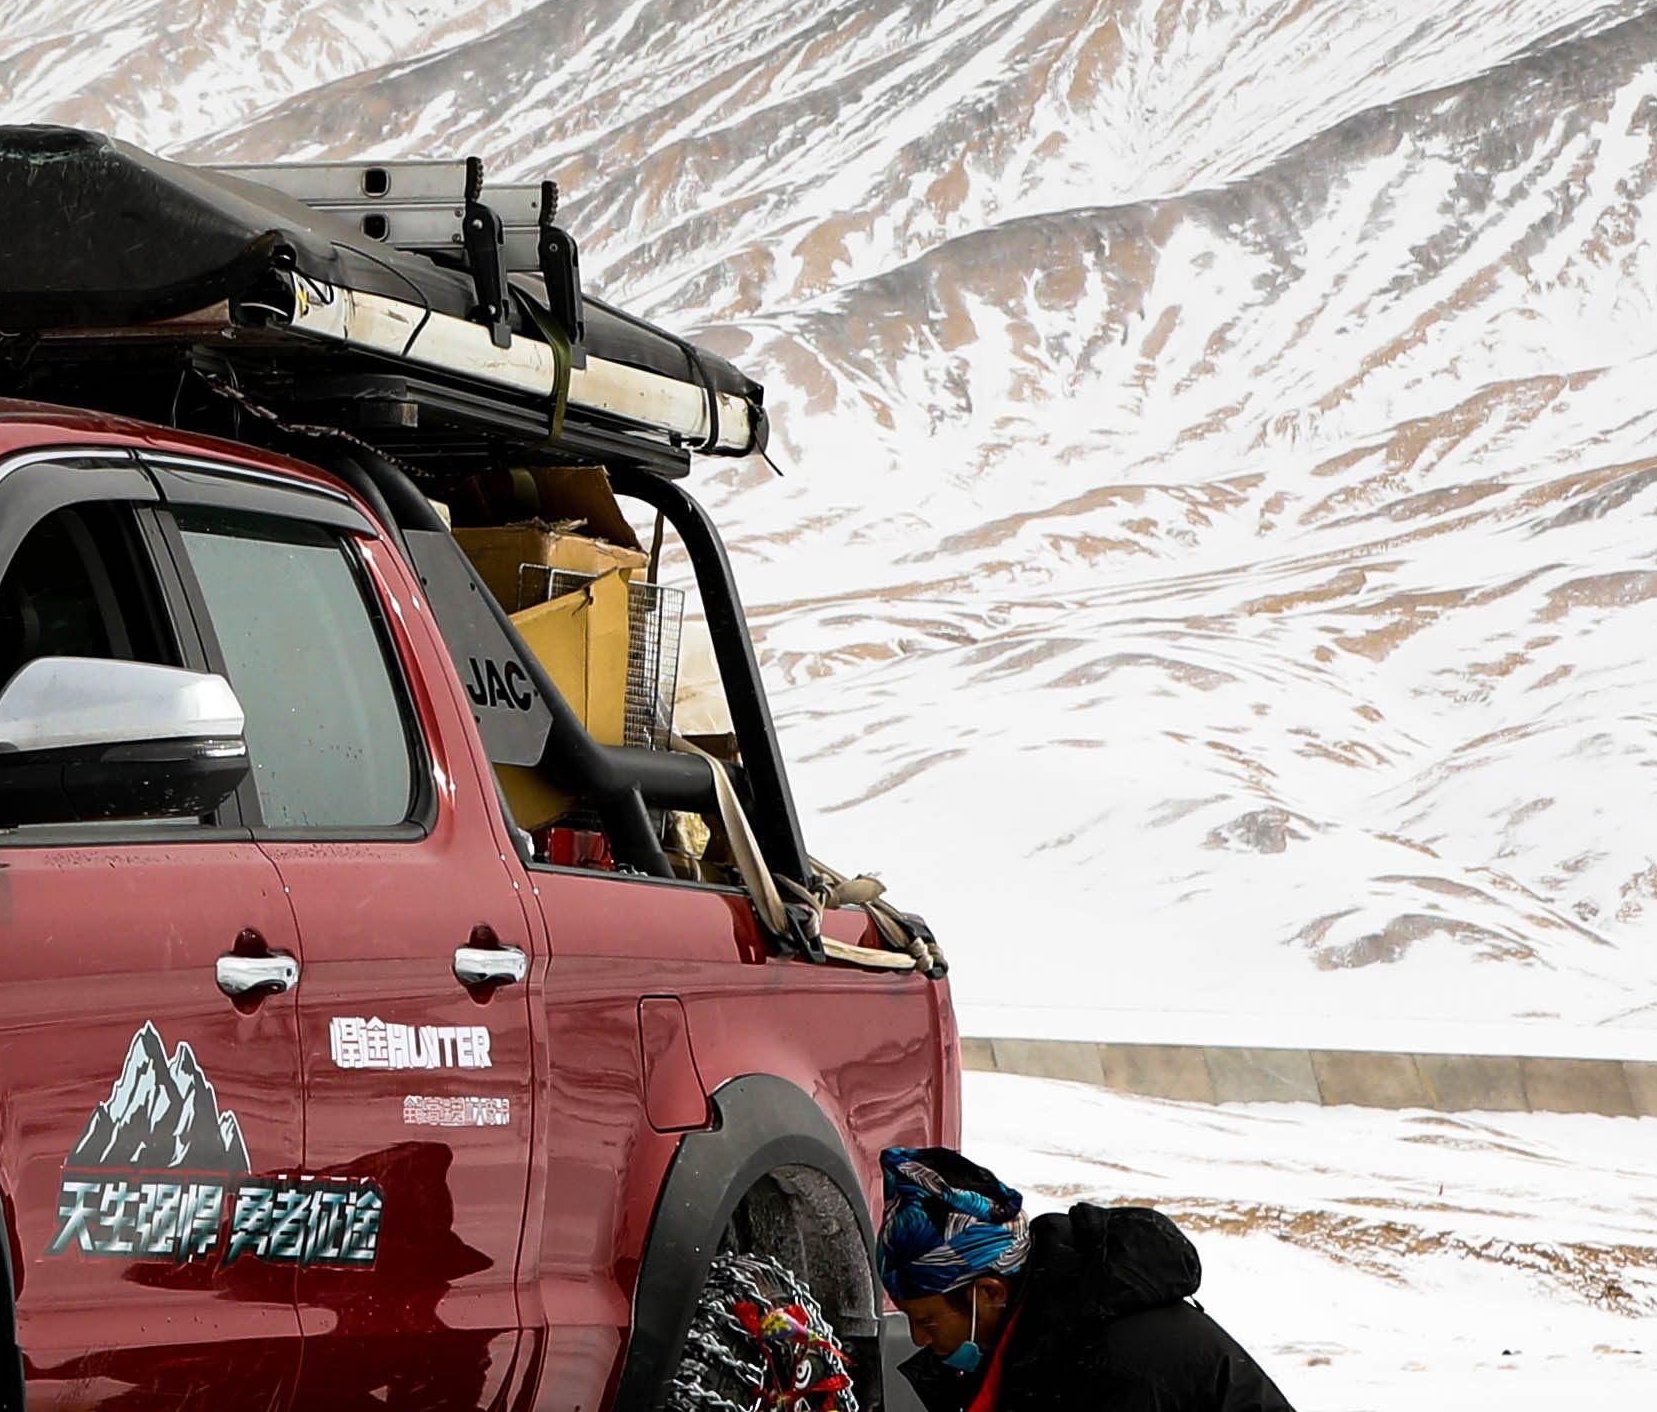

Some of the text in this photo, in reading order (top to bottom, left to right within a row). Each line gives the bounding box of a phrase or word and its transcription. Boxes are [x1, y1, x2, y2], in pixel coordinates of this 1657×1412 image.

[466, 657, 532, 711] JAC
[52, 1181, 383, 1266] 天生强悍 勇者征途
